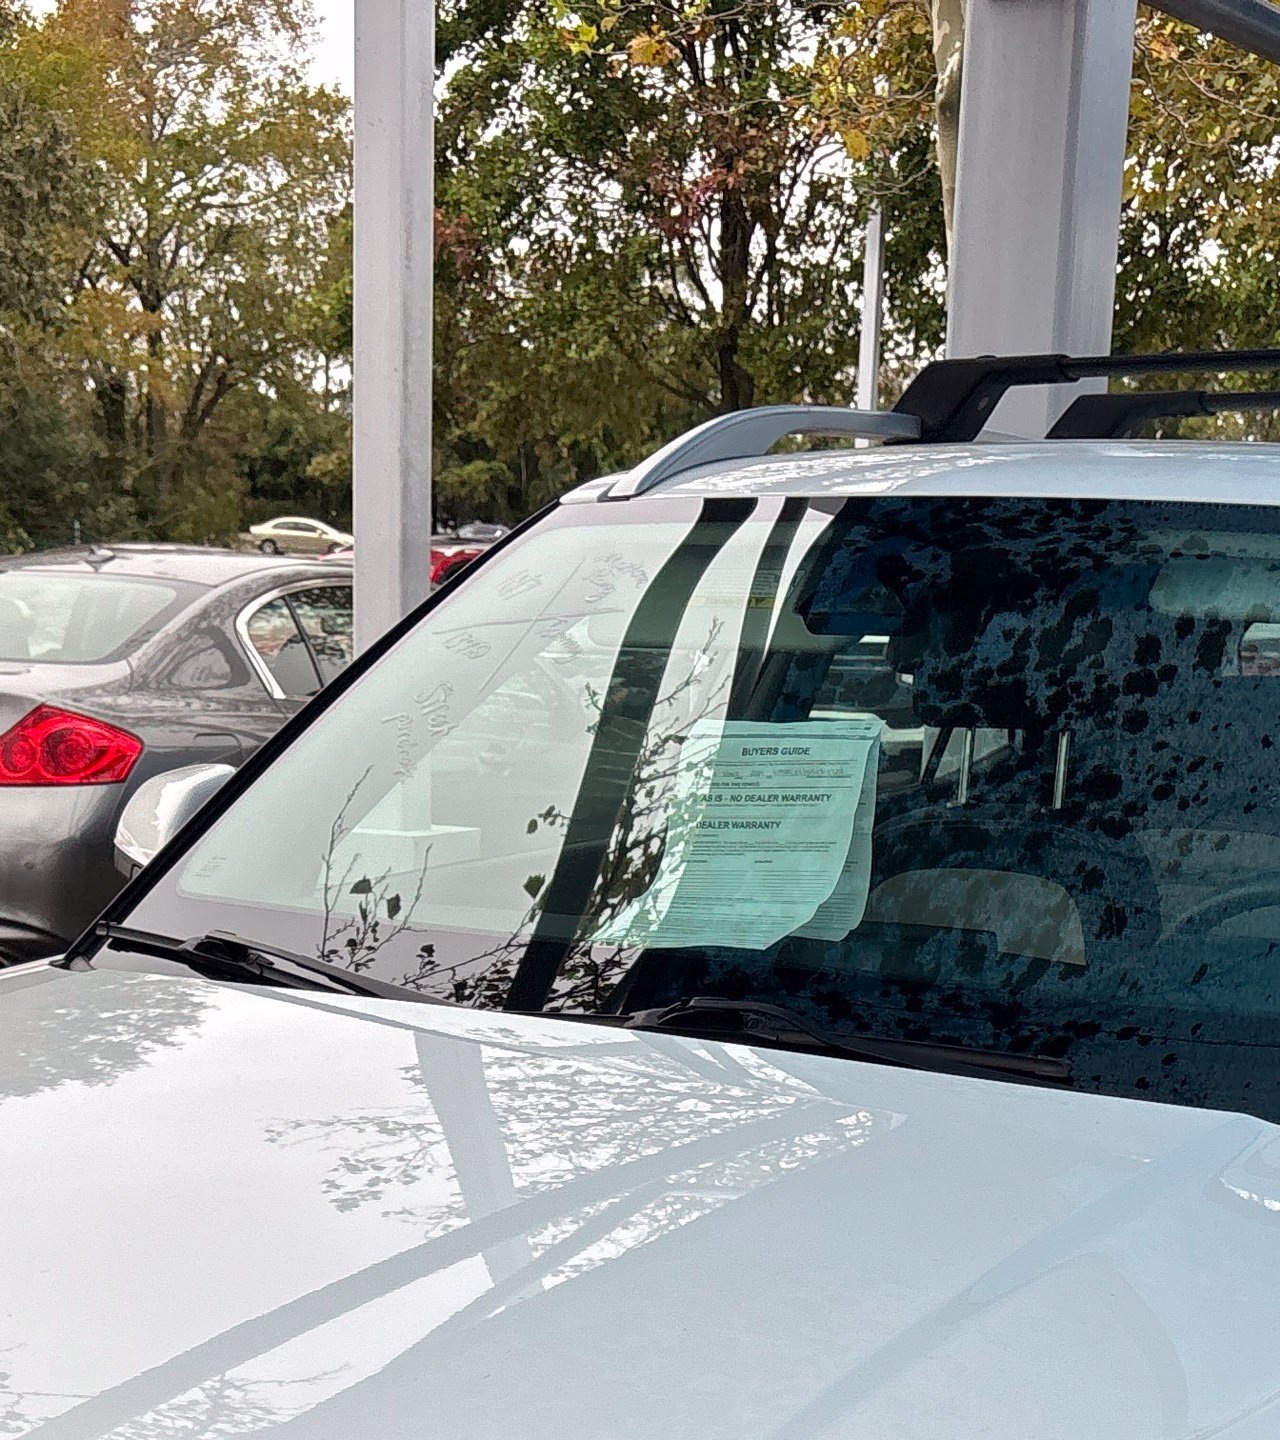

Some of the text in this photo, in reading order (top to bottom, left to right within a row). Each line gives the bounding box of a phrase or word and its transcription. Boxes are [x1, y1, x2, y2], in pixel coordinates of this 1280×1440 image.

[741, 746, 812, 757] BUYERS GUIDE
[700, 794, 714, 803] AS
[729, 794, 743, 803] NO
[744, 793, 780, 802] DEALER
[781, 793, 833, 802] WARRANTY
[695, 820, 782, 830] DEALER WARRANTY
